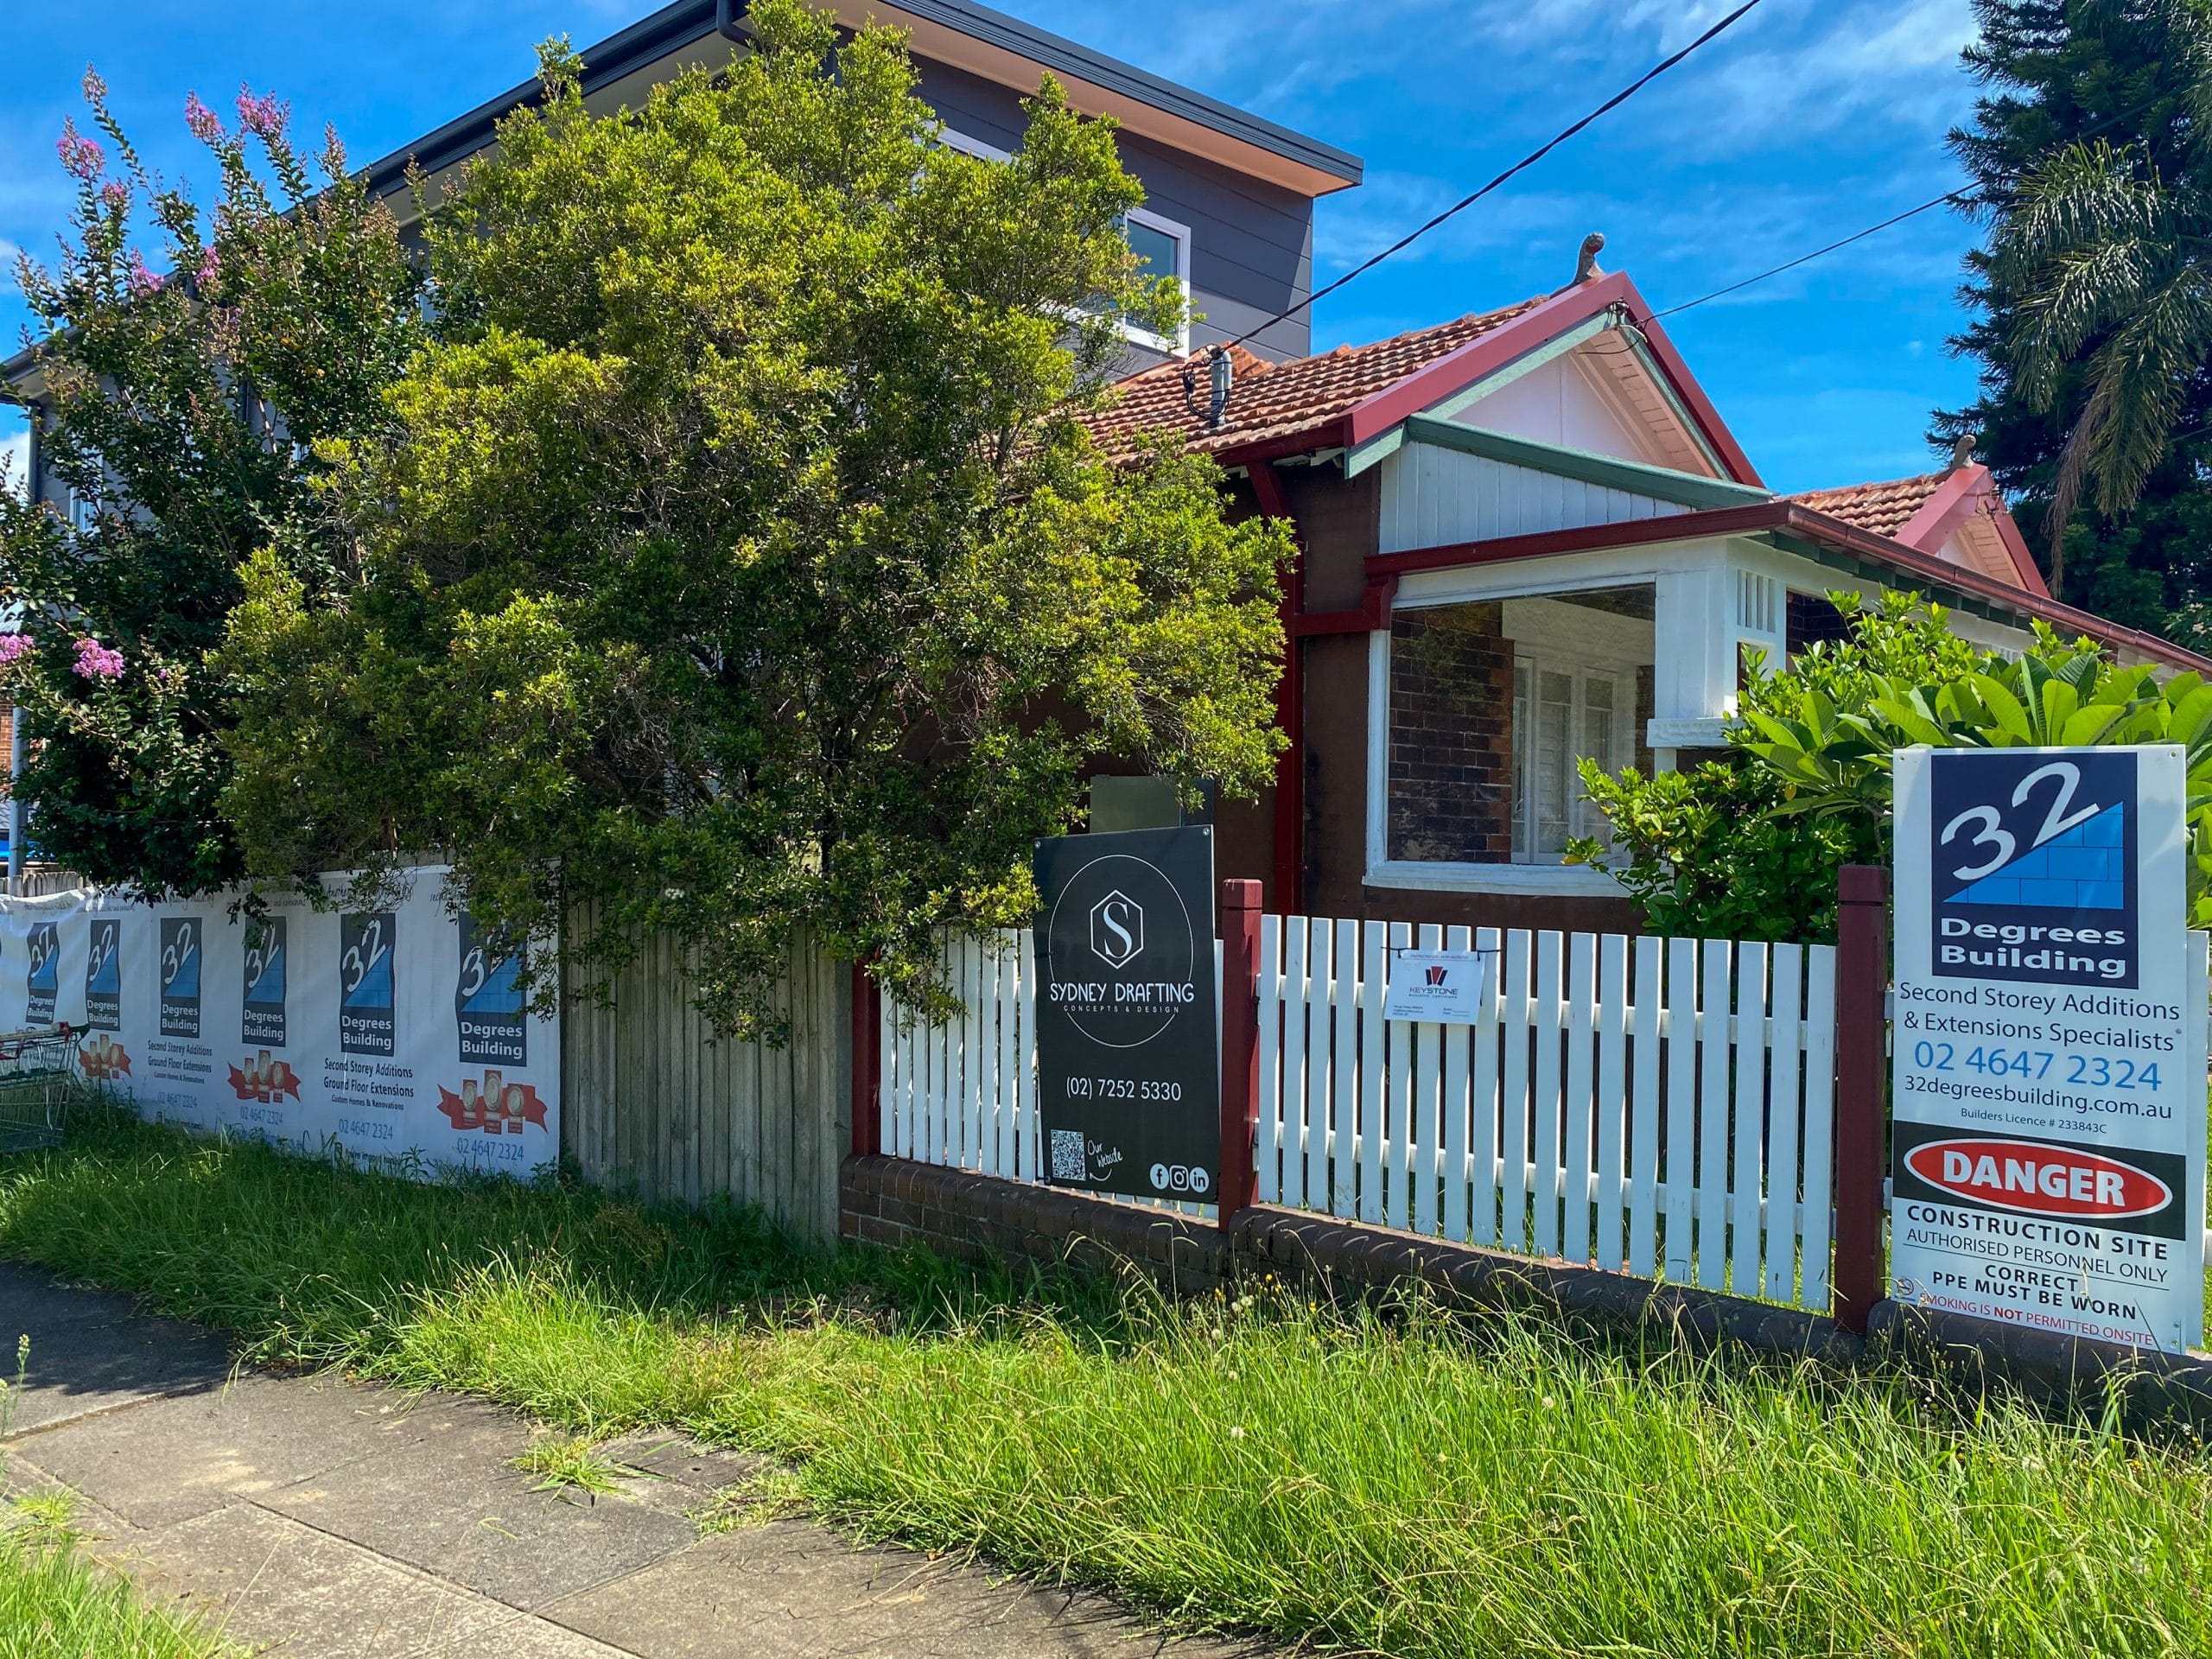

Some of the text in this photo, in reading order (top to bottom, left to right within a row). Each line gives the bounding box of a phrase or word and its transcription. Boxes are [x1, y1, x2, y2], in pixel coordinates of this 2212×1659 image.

[1941, 761, 2101, 880] 32
[1103, 901, 1133, 959] S
[1941, 918, 2126, 945] Degrees
[31, 925, 54, 978] 32
[89, 924, 114, 982] 32
[162, 922, 194, 984] 32
[342, 919, 386, 993] 32
[1941, 944, 2126, 979] Building
[29, 995, 54, 1006] Degrees
[1050, 982, 1195, 1002] SYDNEY DRAFTING
[1409, 987, 1459, 995] KEYSTONE
[1900, 982, 2180, 1020] Second Storey Additions
[27, 1007, 53, 1021] Building
[87, 1000, 118, 1012] Degrees
[162, 1004, 198, 1017] Degrees
[244, 1009, 283, 1023] Degrees
[88, 1013, 118, 1027] Building
[162, 1018, 198, 1033] Building
[341, 1015, 391, 1031] Degrees
[461, 1022, 523, 1038] Degrees
[1904, 1011, 2175, 1052] & Extensions Specialists
[244, 1025, 283, 1041] Building
[342, 1033, 391, 1050] Building
[148, 1039, 213, 1056] Second Storey Additions
[461, 1040, 523, 1059] Building
[148, 1055, 212, 1073] Ground Floor Extensions
[325, 1058, 413, 1078] Second Storey Additions
[1914, 1041, 2163, 1091] 02 4647 2324
[324, 1077, 414, 1097] Ground Floor Extensions
[1066, 1077, 1182, 1101] (02) 7252 5330
[1904, 1075, 2172, 1119] 32degreesbuilding.com.au
[240, 1106, 248, 1120] 02
[267, 1110, 283, 1125] 2324
[1961, 1108, 2003, 1122] Builders
[2005, 1113, 2046, 1127] Licence
[2058, 1119, 2107, 1134] 233843C
[339, 1118, 393, 1140] 02 4647 2324
[457, 1137, 524, 1161] 02 4647 2324
[1087, 1140, 1103, 1155] Our
[1943, 1149, 2126, 1207] DANGER
[1907, 1205, 2168, 1261] CONSTRUCTION SITE
[1907, 1229, 2169, 1283] AUTHORISED PERSONNEL ONLY
[1985, 1264, 2079, 1292] CORRECT
[1933, 1271, 2137, 1319] PPE MUST BE WORN
[1920, 1293, 2153, 1345] SMOKING IS NOT PERMITTED ONSITE
